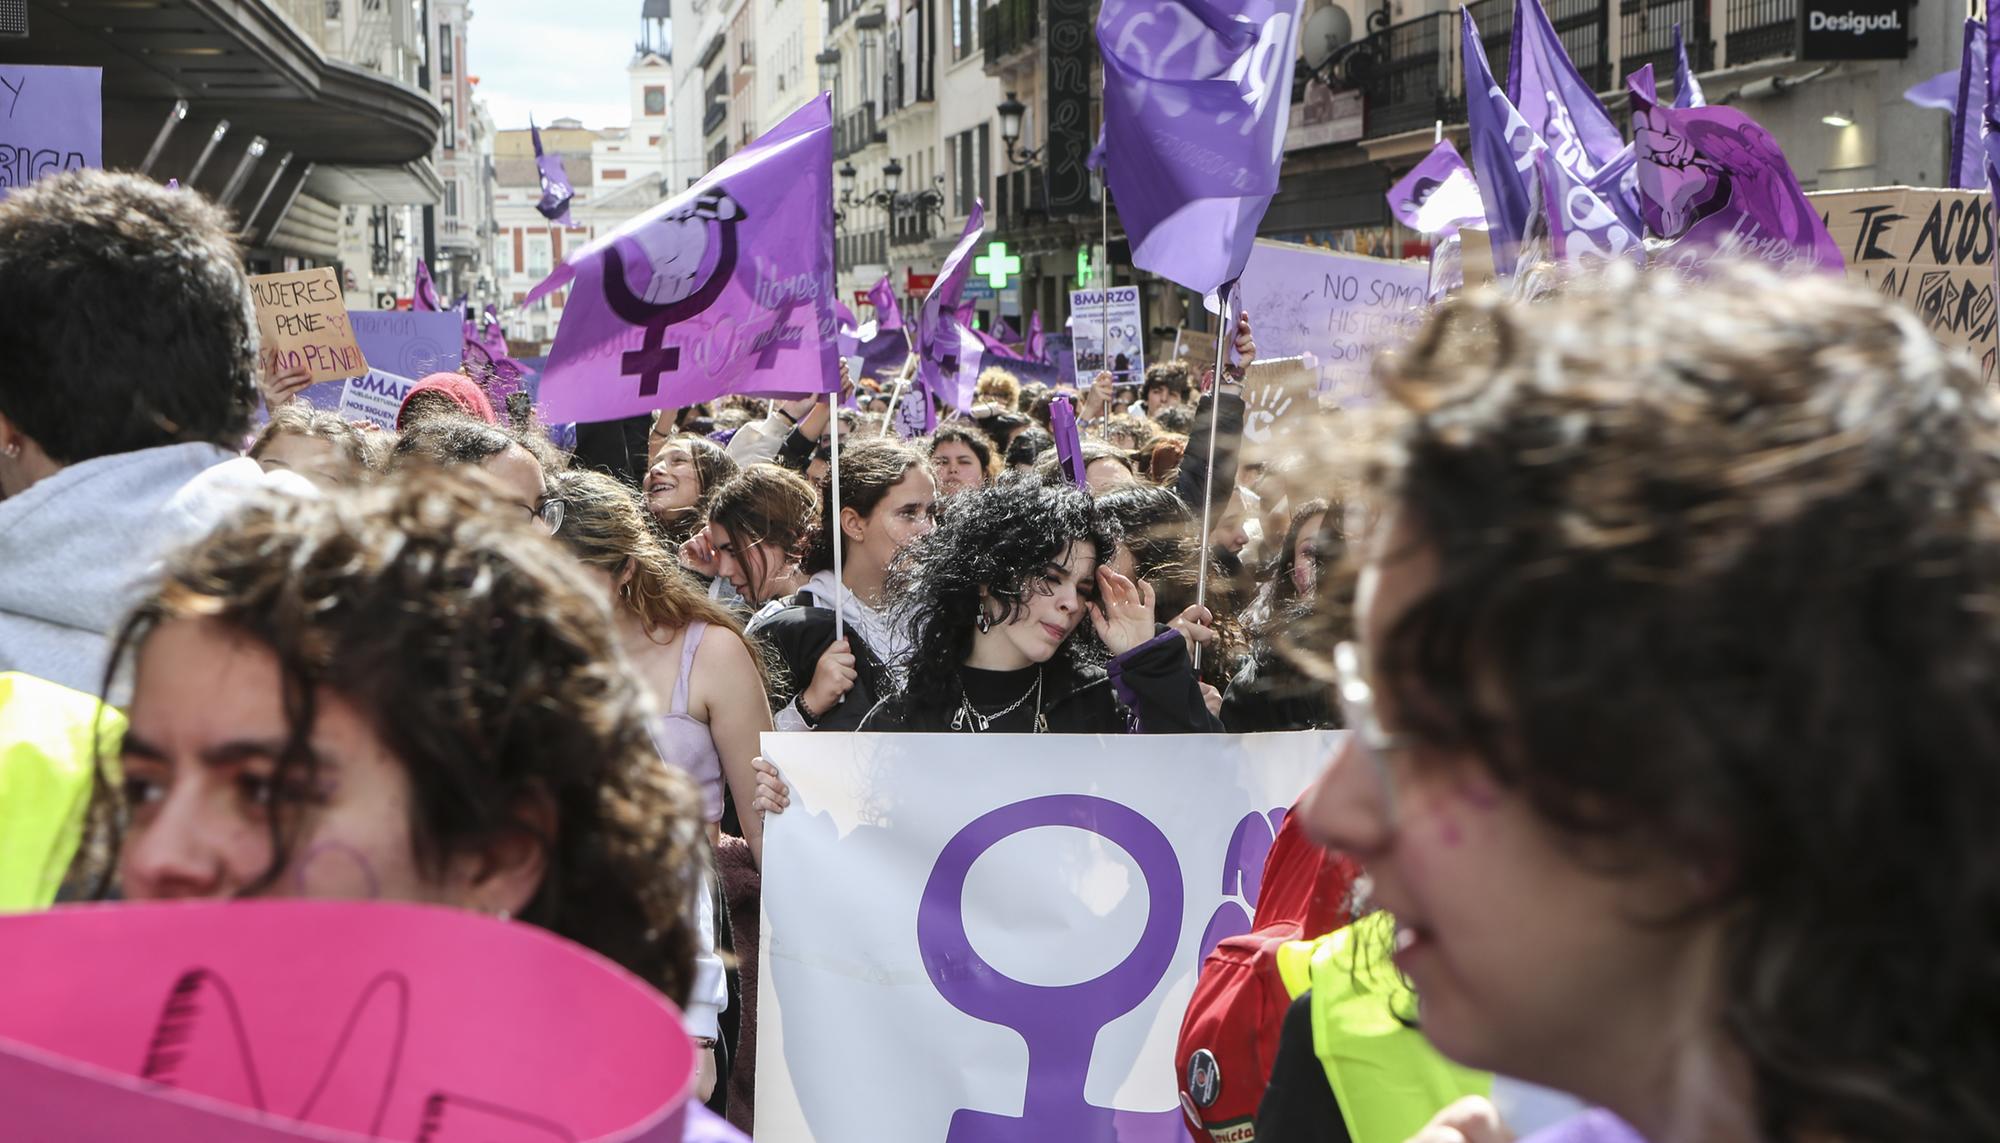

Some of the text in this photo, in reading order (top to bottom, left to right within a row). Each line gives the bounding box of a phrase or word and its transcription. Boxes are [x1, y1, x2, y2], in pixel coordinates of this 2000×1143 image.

[1809, 10, 1902, 35] Desigual.
[1850, 195, 1994, 265] TE ACOS
[250, 279, 337, 308] MUJERES
[1074, 290, 1135, 305] 8MARZO
[1323, 273, 1358, 302] NO
[275, 313, 326, 336] PENE
